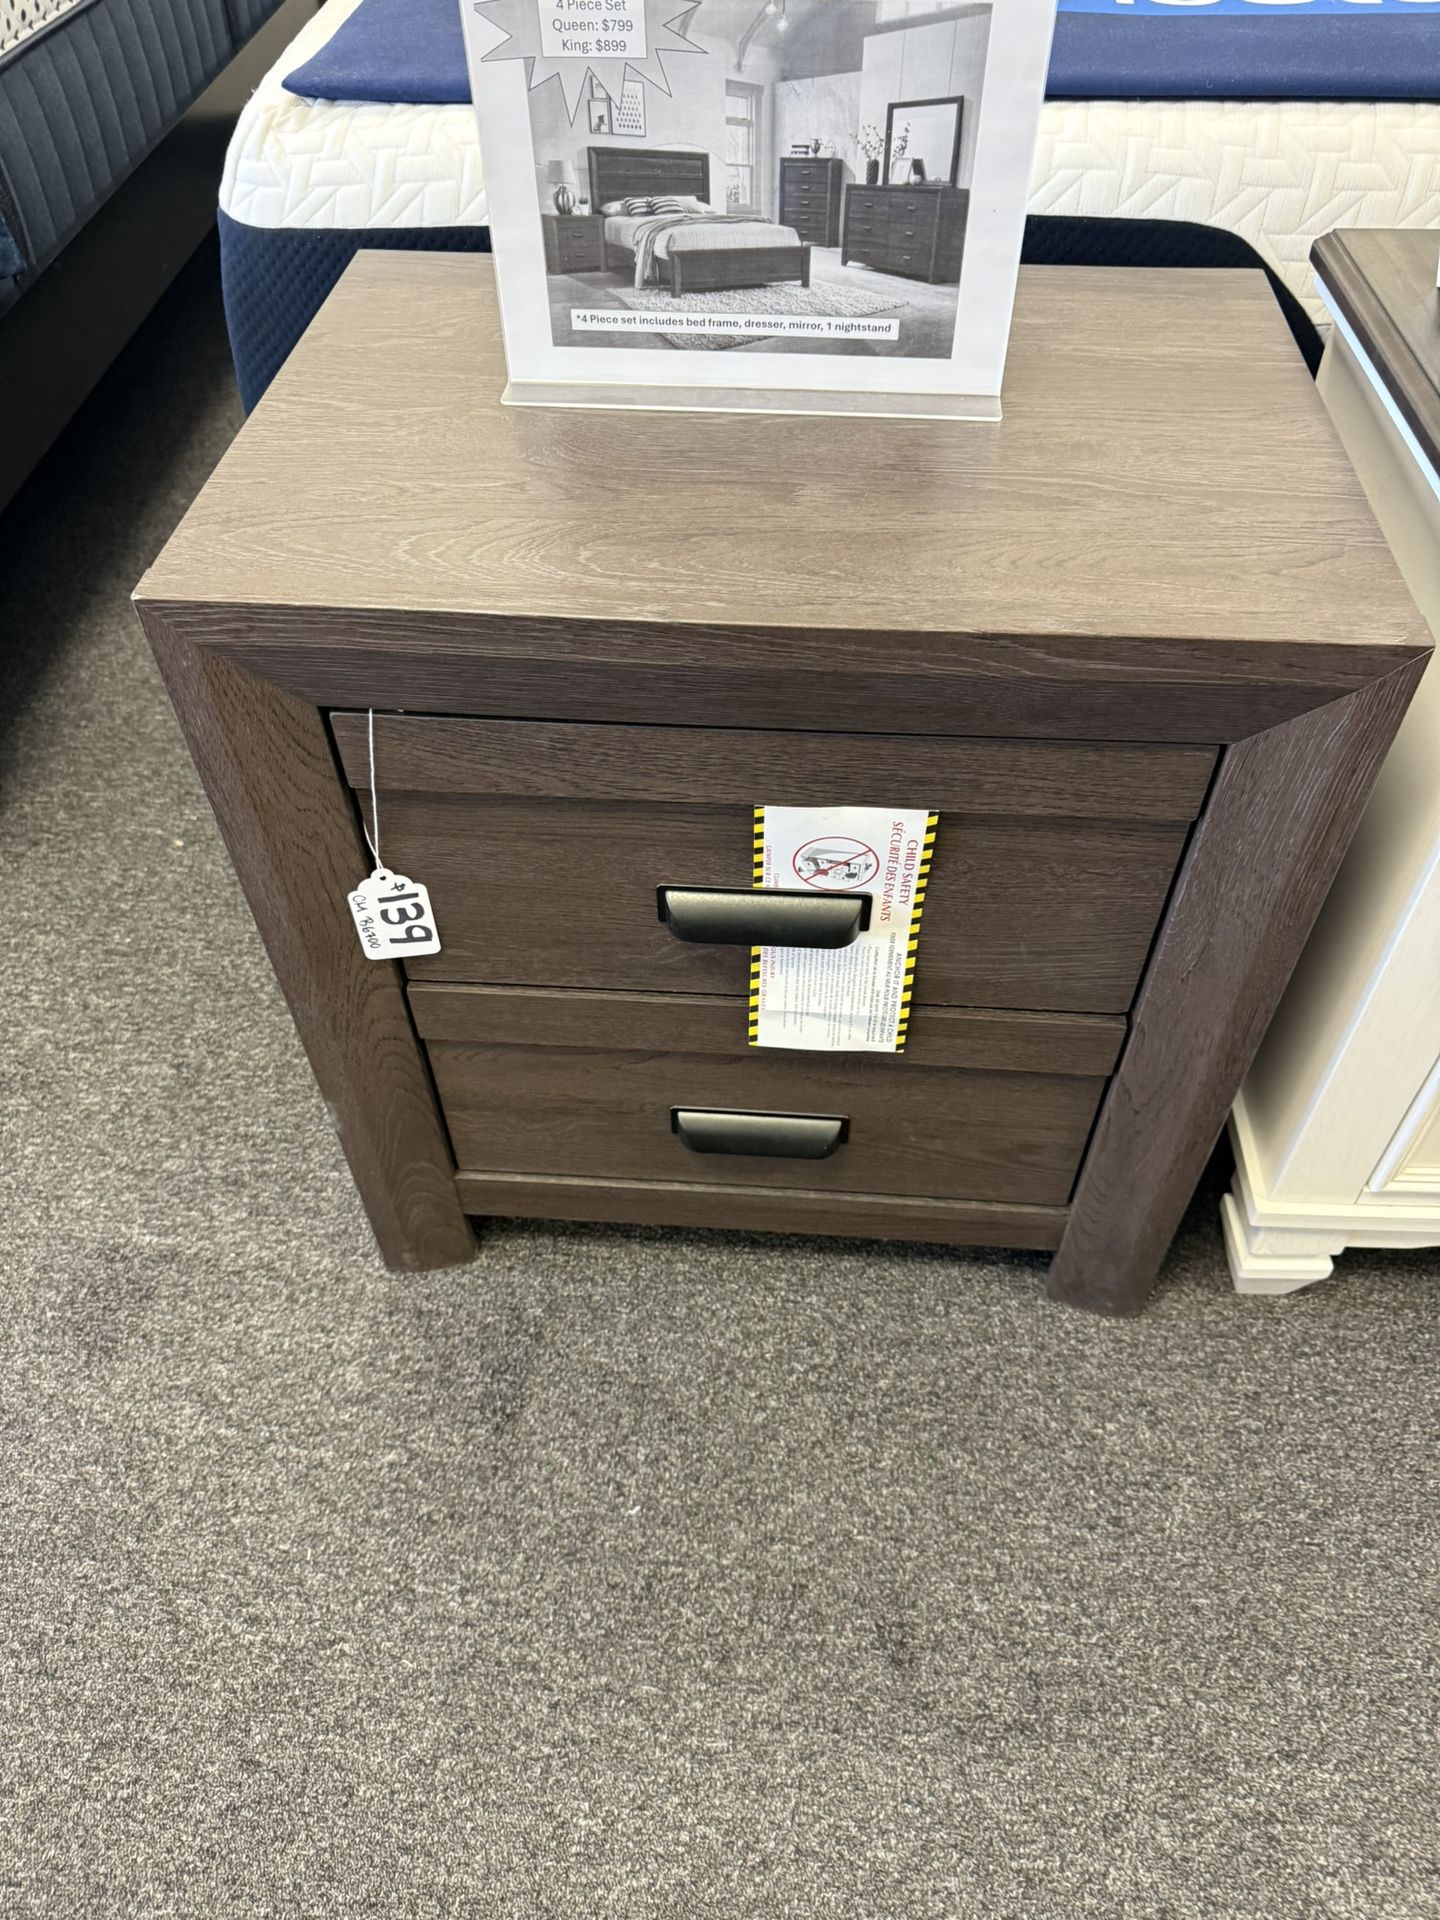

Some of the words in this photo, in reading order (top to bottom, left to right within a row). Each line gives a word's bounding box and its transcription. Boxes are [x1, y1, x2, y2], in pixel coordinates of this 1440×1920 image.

[556, 0, 564, 10] 4
[567, 0, 602, 11] Piece
[605, 0, 627, 11] Set
[552, 18, 599, 33] Queen:
[602, 18, 634, 32] $799
[561, 38, 592, 54] King:
[595, 38, 627, 53] $899
[590, 314, 619, 325] Piece
[621, 315, 637, 325] set
[639, 315, 684, 327] includes
[686, 317, 706, 327] bed
[708, 318, 741, 330] frame,
[744, 319, 786, 330] dresser,
[789, 320, 824, 332] mirror,
[834, 322, 891, 333] nightstand
[887, 821, 906, 864] SÉCURITÉ
[904, 840, 918, 870] CHILD
[885, 866, 897, 881] DES
[898, 873, 913, 906] SAFETY
[880, 883, 895, 922] ENFANTS
[894, 953, 902, 979] ANCHOR
[888, 1000, 897, 1024] PROTECT
